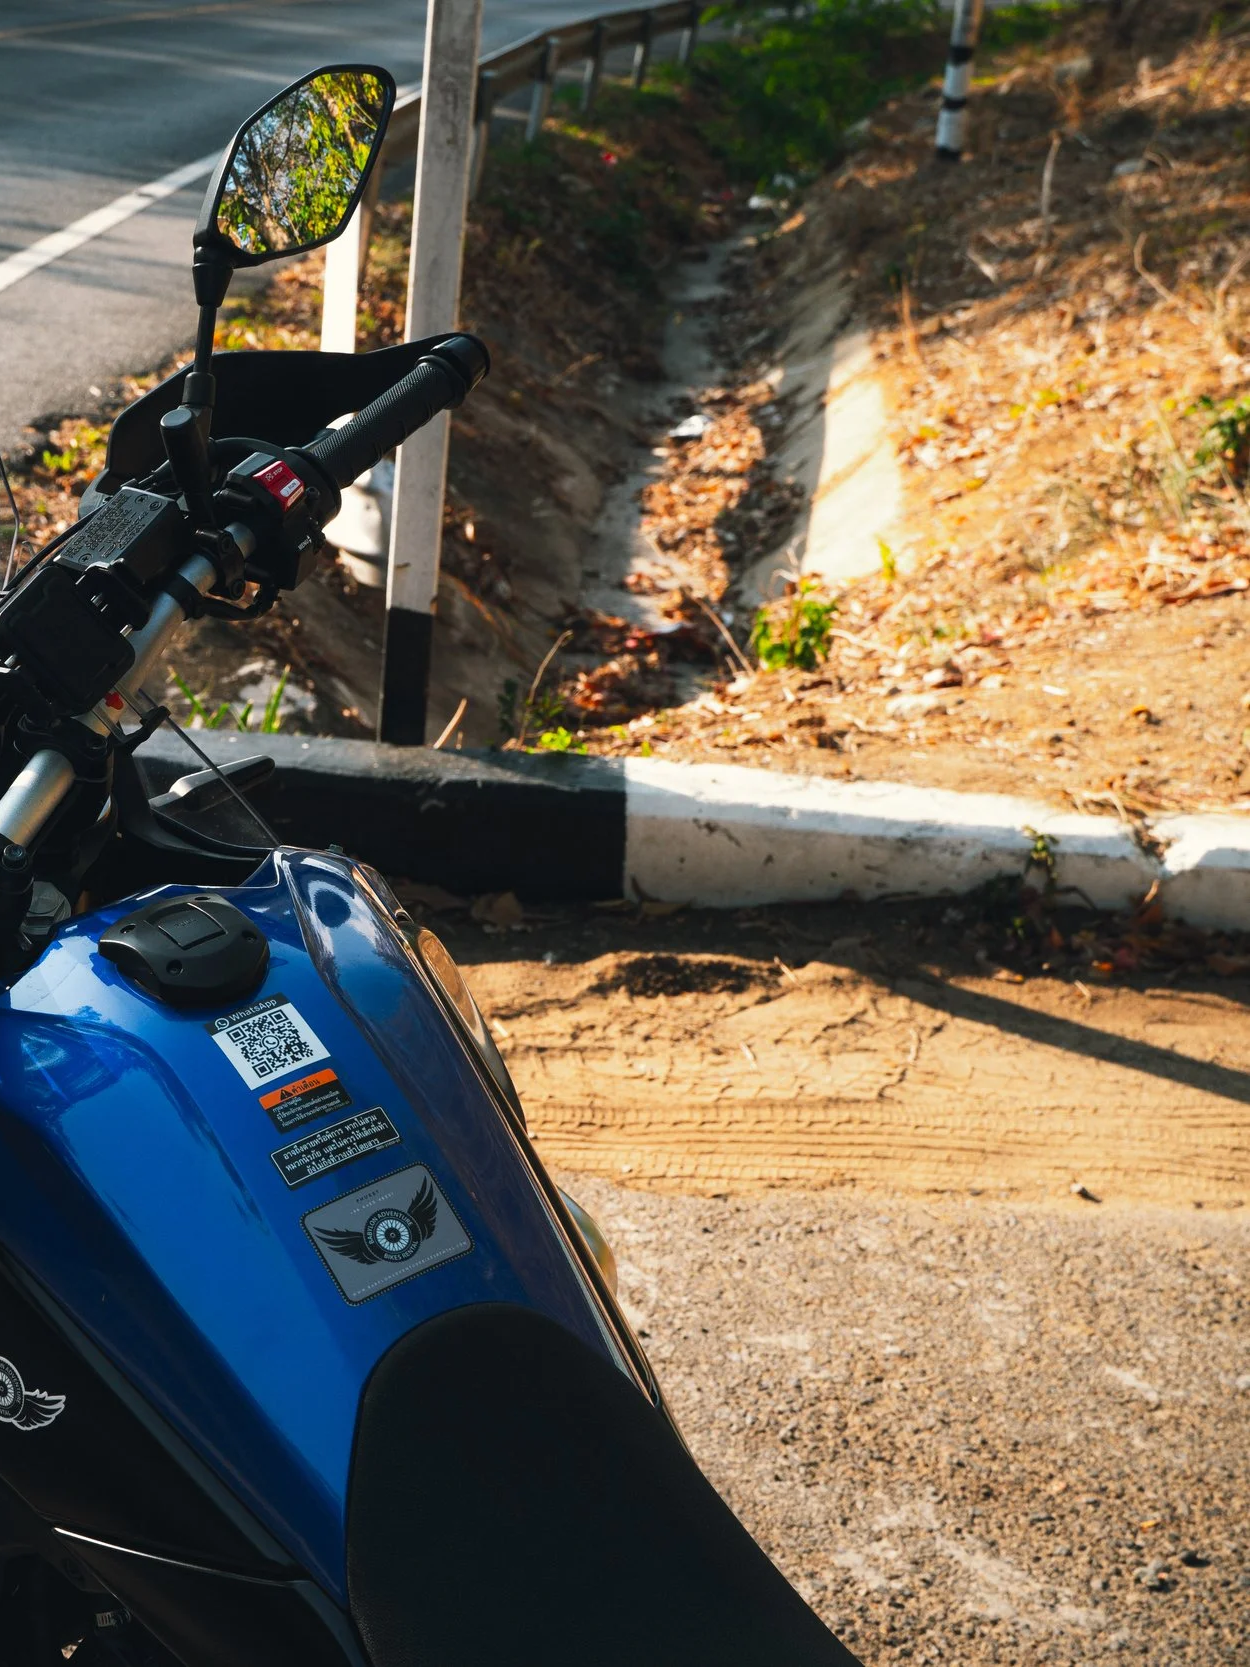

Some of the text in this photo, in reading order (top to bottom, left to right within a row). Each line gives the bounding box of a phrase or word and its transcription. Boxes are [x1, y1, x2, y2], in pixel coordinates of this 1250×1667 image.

[228, 998, 278, 1022] WhatsApp
[366, 1211, 414, 1245] BABYLON ADVENTURE
[383, 1240, 419, 1261] BIKES RENTAL
